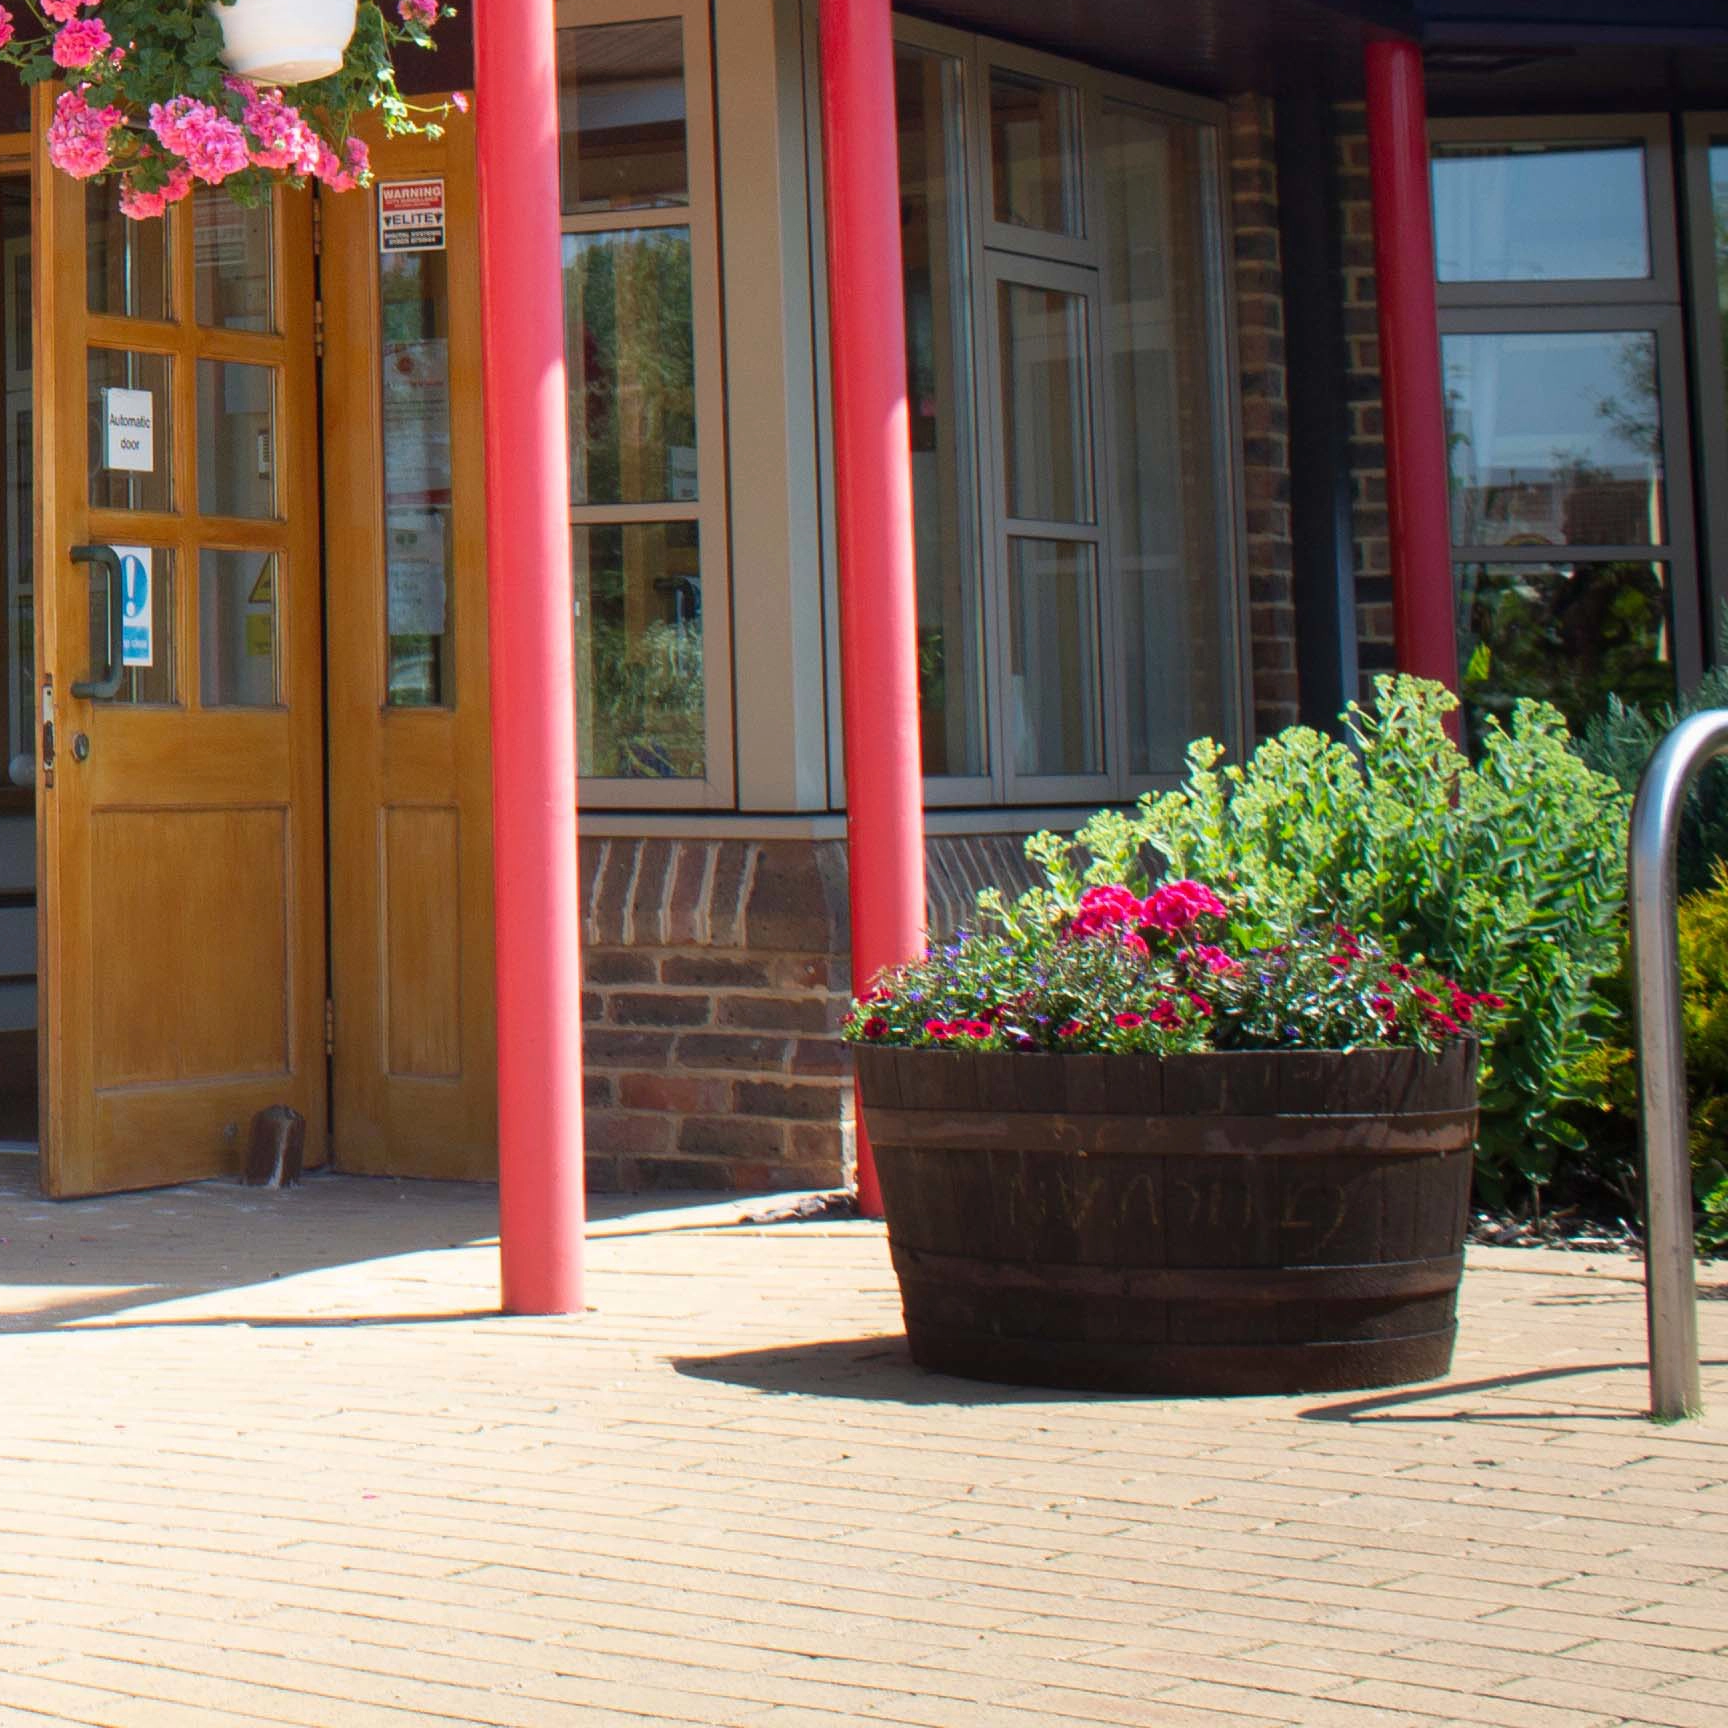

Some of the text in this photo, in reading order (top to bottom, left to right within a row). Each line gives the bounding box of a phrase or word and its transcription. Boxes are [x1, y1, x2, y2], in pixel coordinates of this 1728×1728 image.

[383, 186, 442, 200] WARNING
[392, 212, 434, 225] ELITE
[109, 413, 151, 429] Automatic
[120, 438, 140, 451] door
